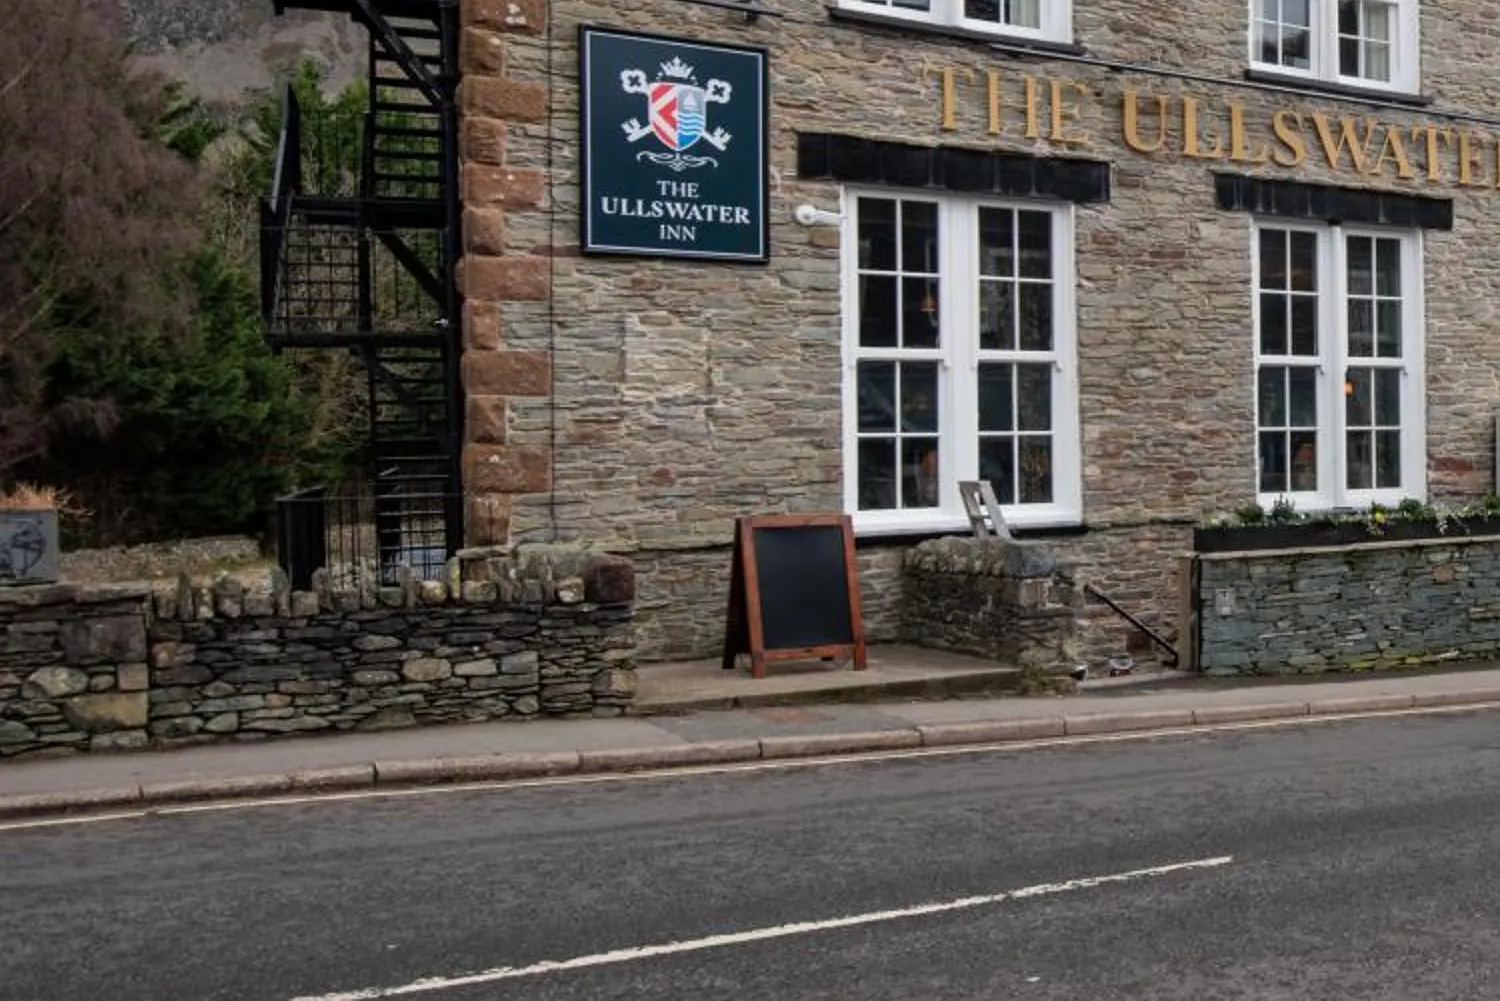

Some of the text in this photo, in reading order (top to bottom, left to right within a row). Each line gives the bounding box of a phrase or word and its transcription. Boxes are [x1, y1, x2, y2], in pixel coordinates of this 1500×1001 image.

[920, 57, 1089, 145] THE
[657, 180, 699, 197] THE
[601, 196, 750, 224] ULLSWATER
[659, 224, 696, 241] INN
